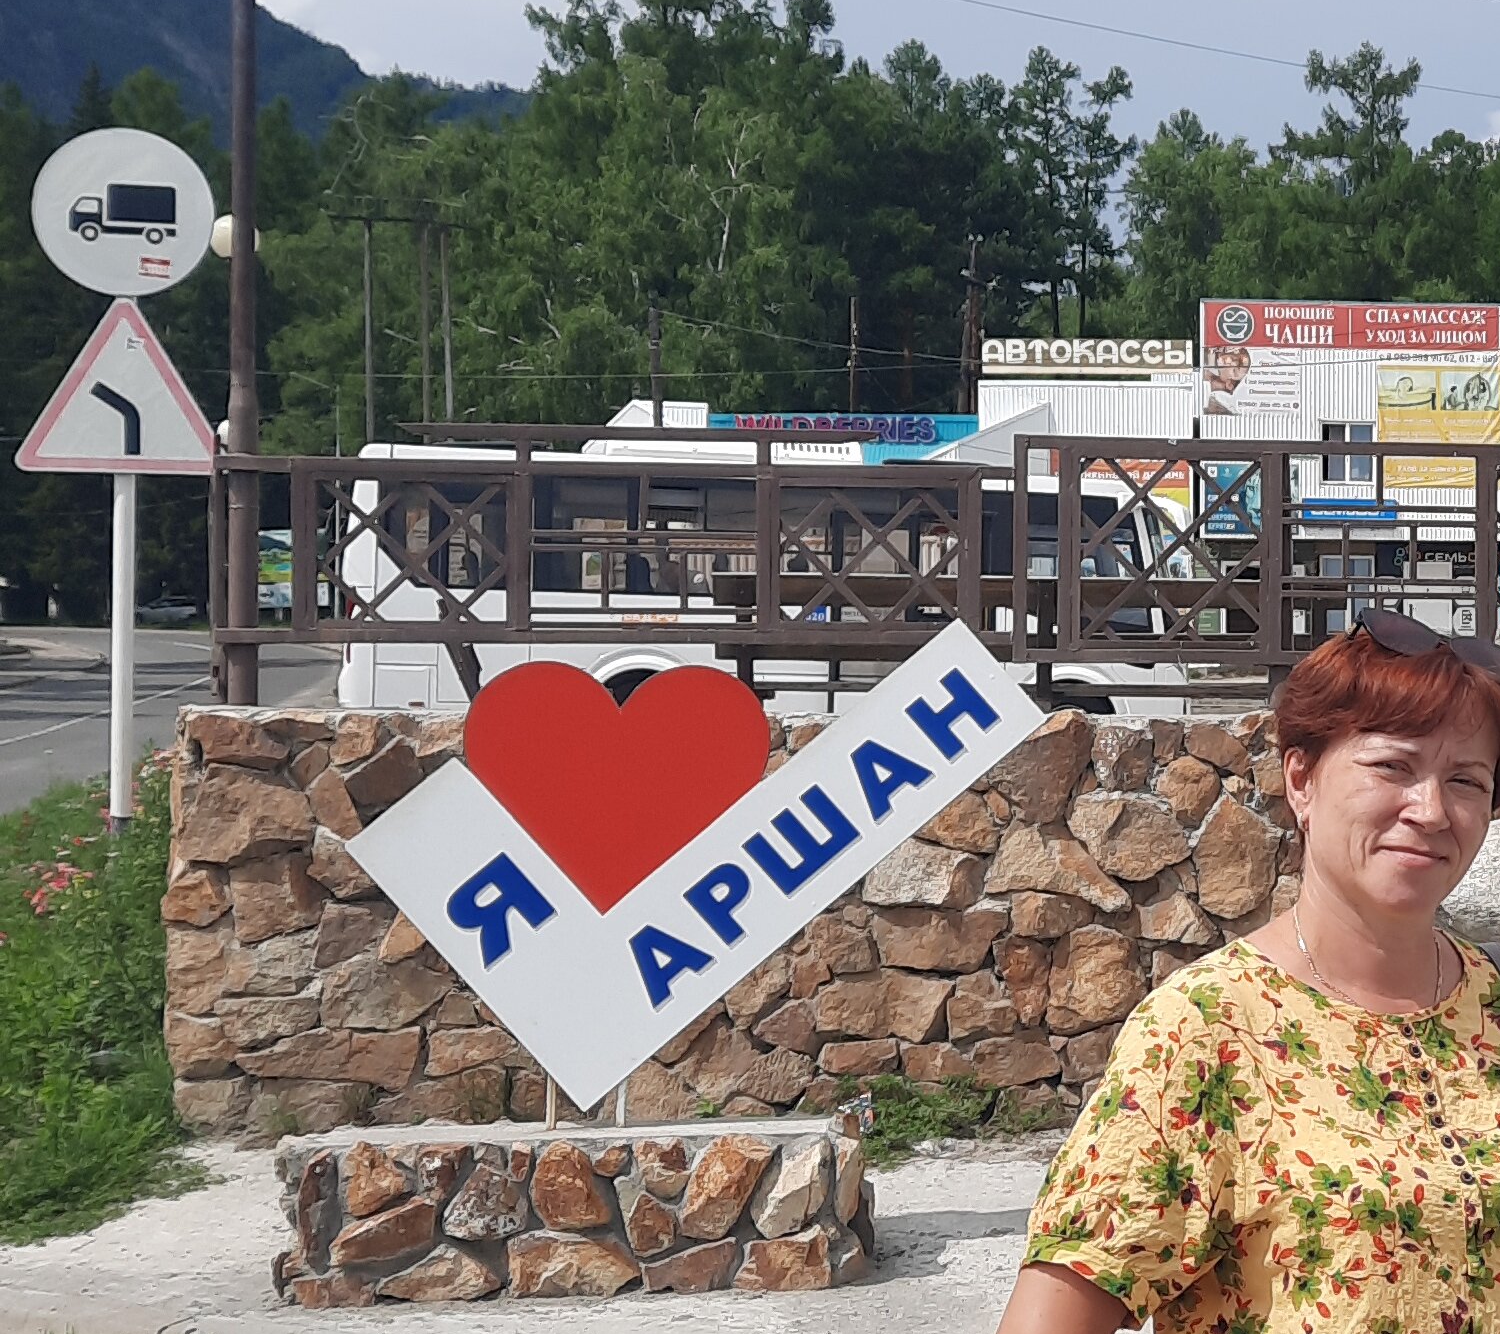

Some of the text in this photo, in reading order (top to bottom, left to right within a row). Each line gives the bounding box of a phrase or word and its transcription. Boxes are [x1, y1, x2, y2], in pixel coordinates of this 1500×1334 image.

[1264, 307, 1334, 320] ПОЮЩИЕ
[1365, 309, 1487, 326] СПА МАССАЖ
[1264, 323, 1334, 345] ЧАШИ
[1365, 329, 1487, 345] УХОД ЗА ЛИЦОМ
[981, 338, 1192, 365] АВТОКАССЫ
[627, 667, 1002, 1013] АРШАН
[446, 851, 558, 971] Я
